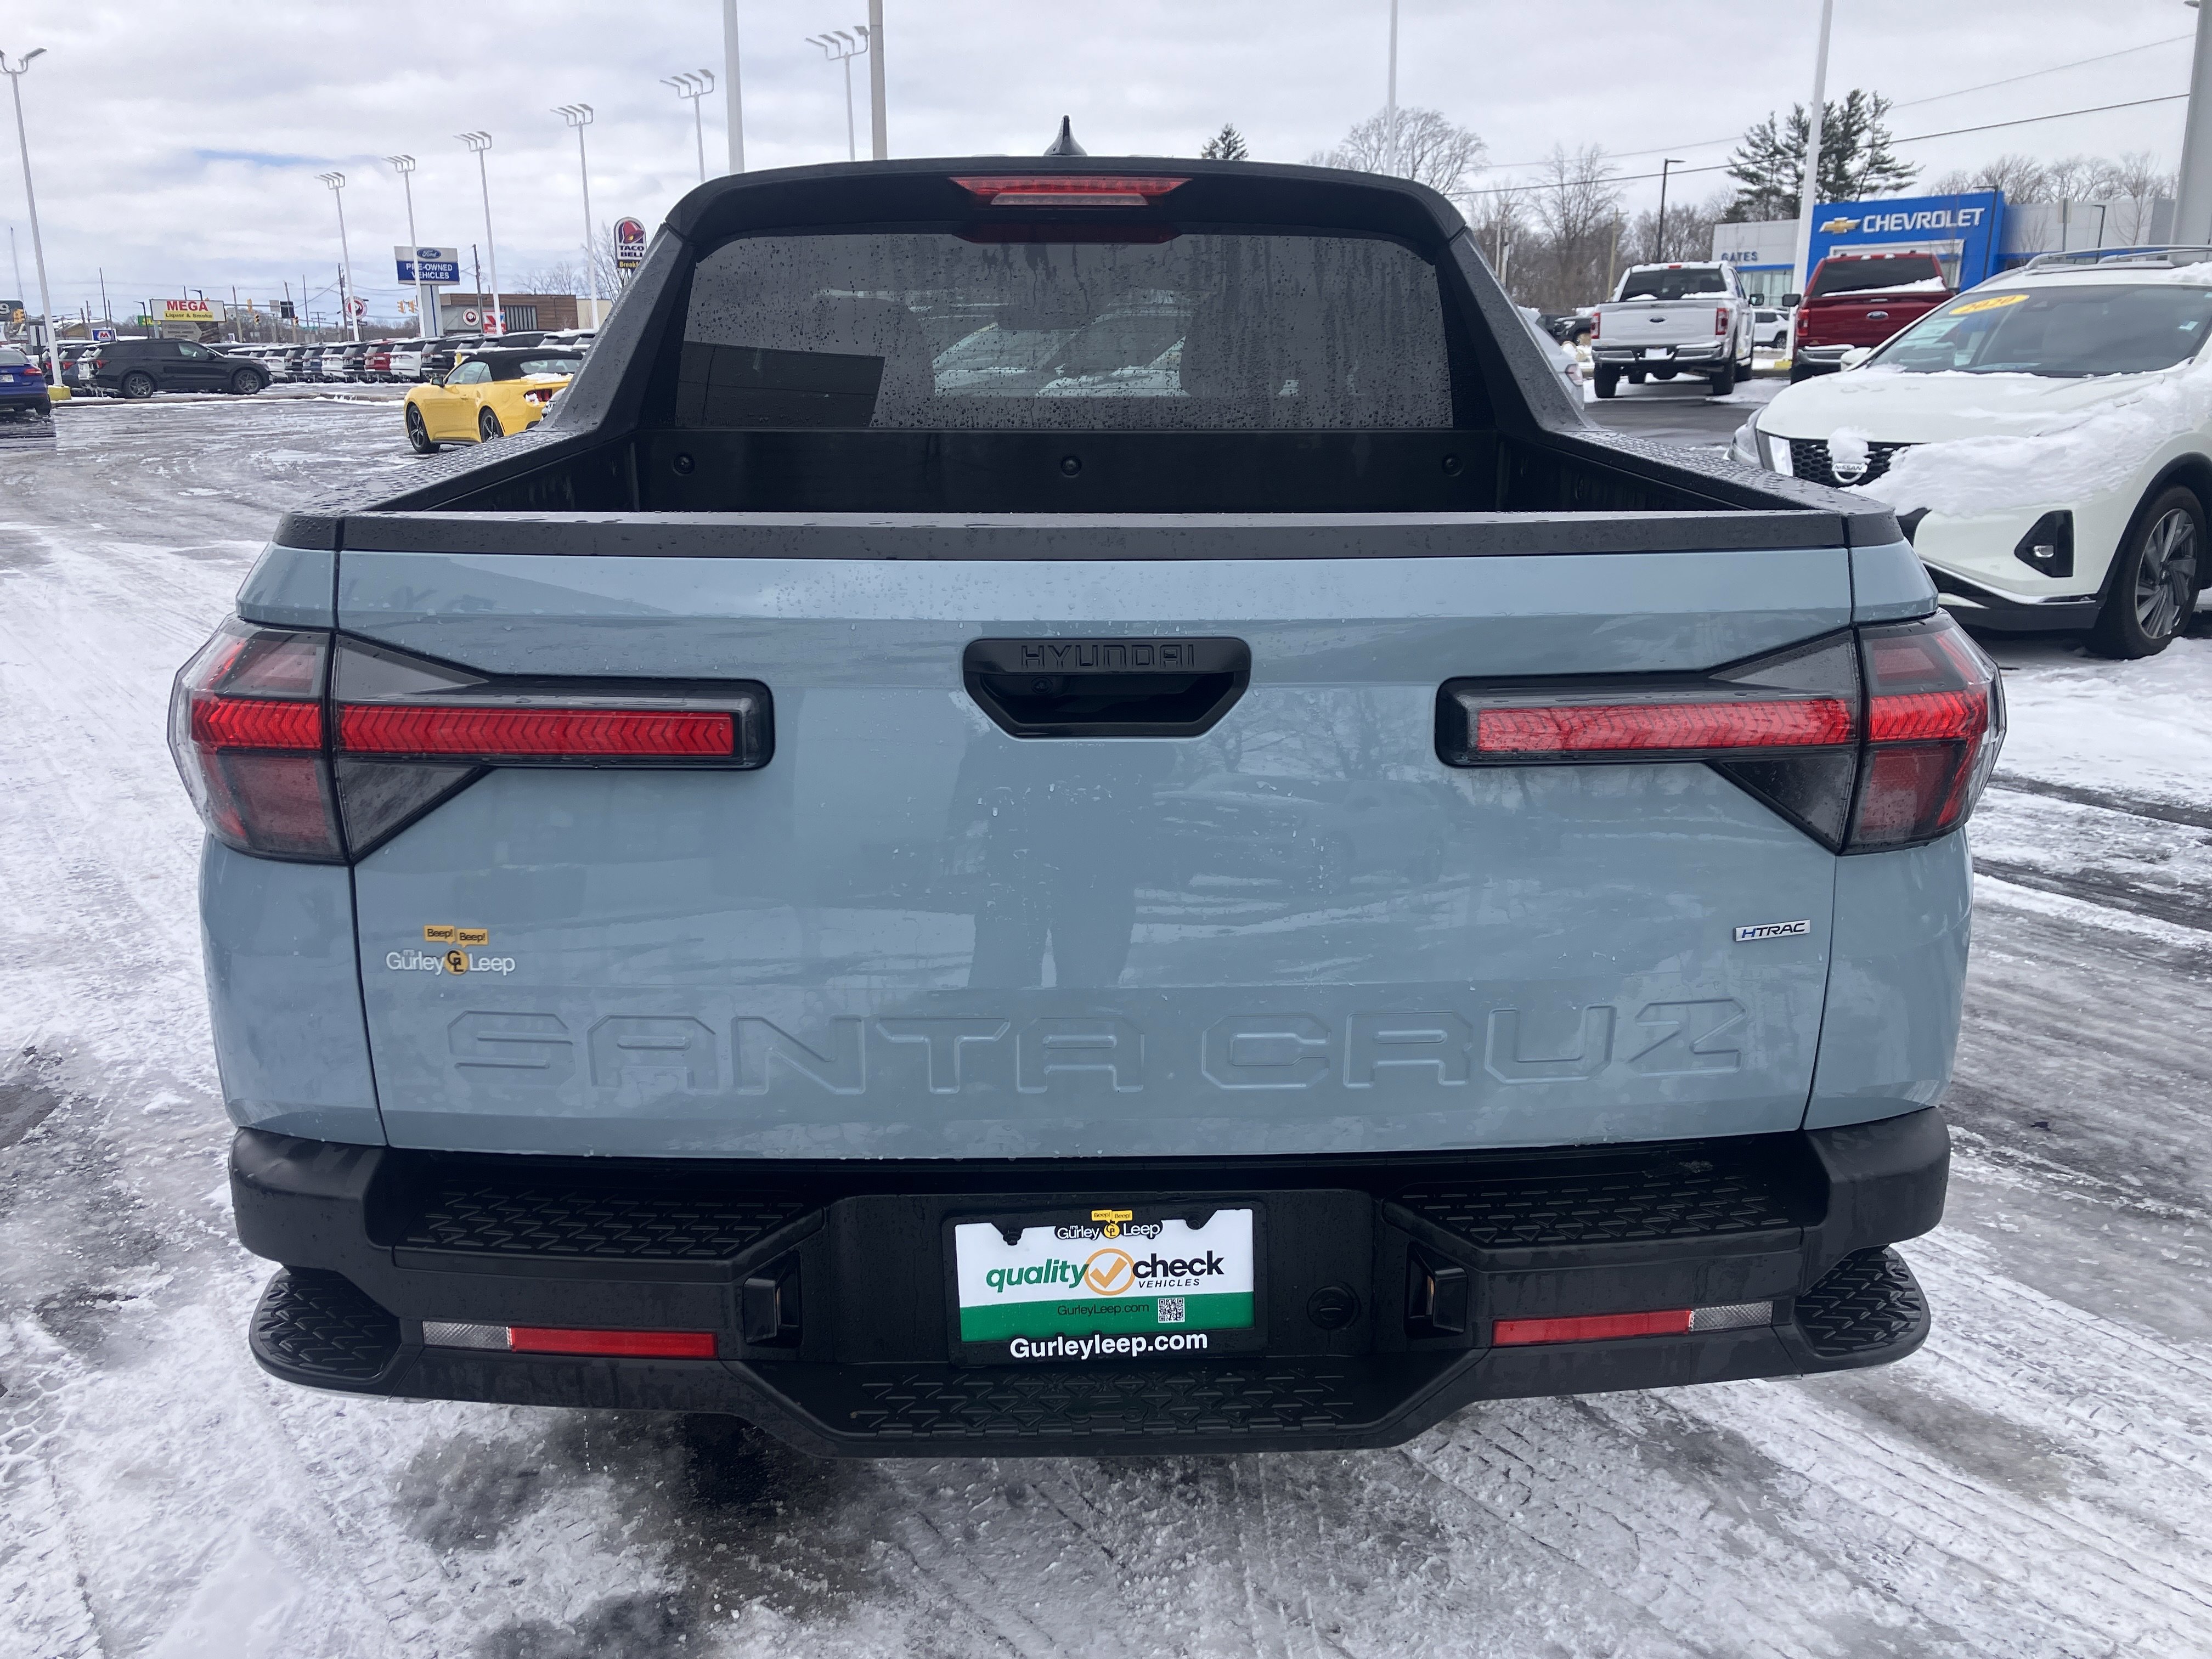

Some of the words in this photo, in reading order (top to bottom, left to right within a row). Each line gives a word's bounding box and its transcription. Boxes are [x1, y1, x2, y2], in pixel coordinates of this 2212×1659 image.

[1862, 207, 1985, 233] CHEVROLET
[1721, 251, 1759, 262] GATES
[406, 263, 453, 272] PE-OWNED
[166, 301, 208, 312] MEGA
[1021, 644, 1195, 669] HYUNDAI
[427, 929, 454, 939] Beep!
[459, 932, 486, 943] Beep!
[1741, 922, 1805, 938] HTRAC
[386, 951, 445, 975] Gurley
[469, 952, 516, 976] Leep
[446, 1011, 1147, 1096] SANTA
[1201, 998, 1747, 1088] CRUZ
[1057, 1225, 1100, 1240] Gurley
[1123, 1223, 1160, 1238] Leep
[986, 1259, 1090, 1293] quality
[1132, 1250, 1224, 1278] check
[1138, 1278, 1200, 1289] VEHICLES
[1057, 1304, 1149, 1317] GurleyLeep.com
[1009, 1333, 1208, 1361] Gurleyleep.com
